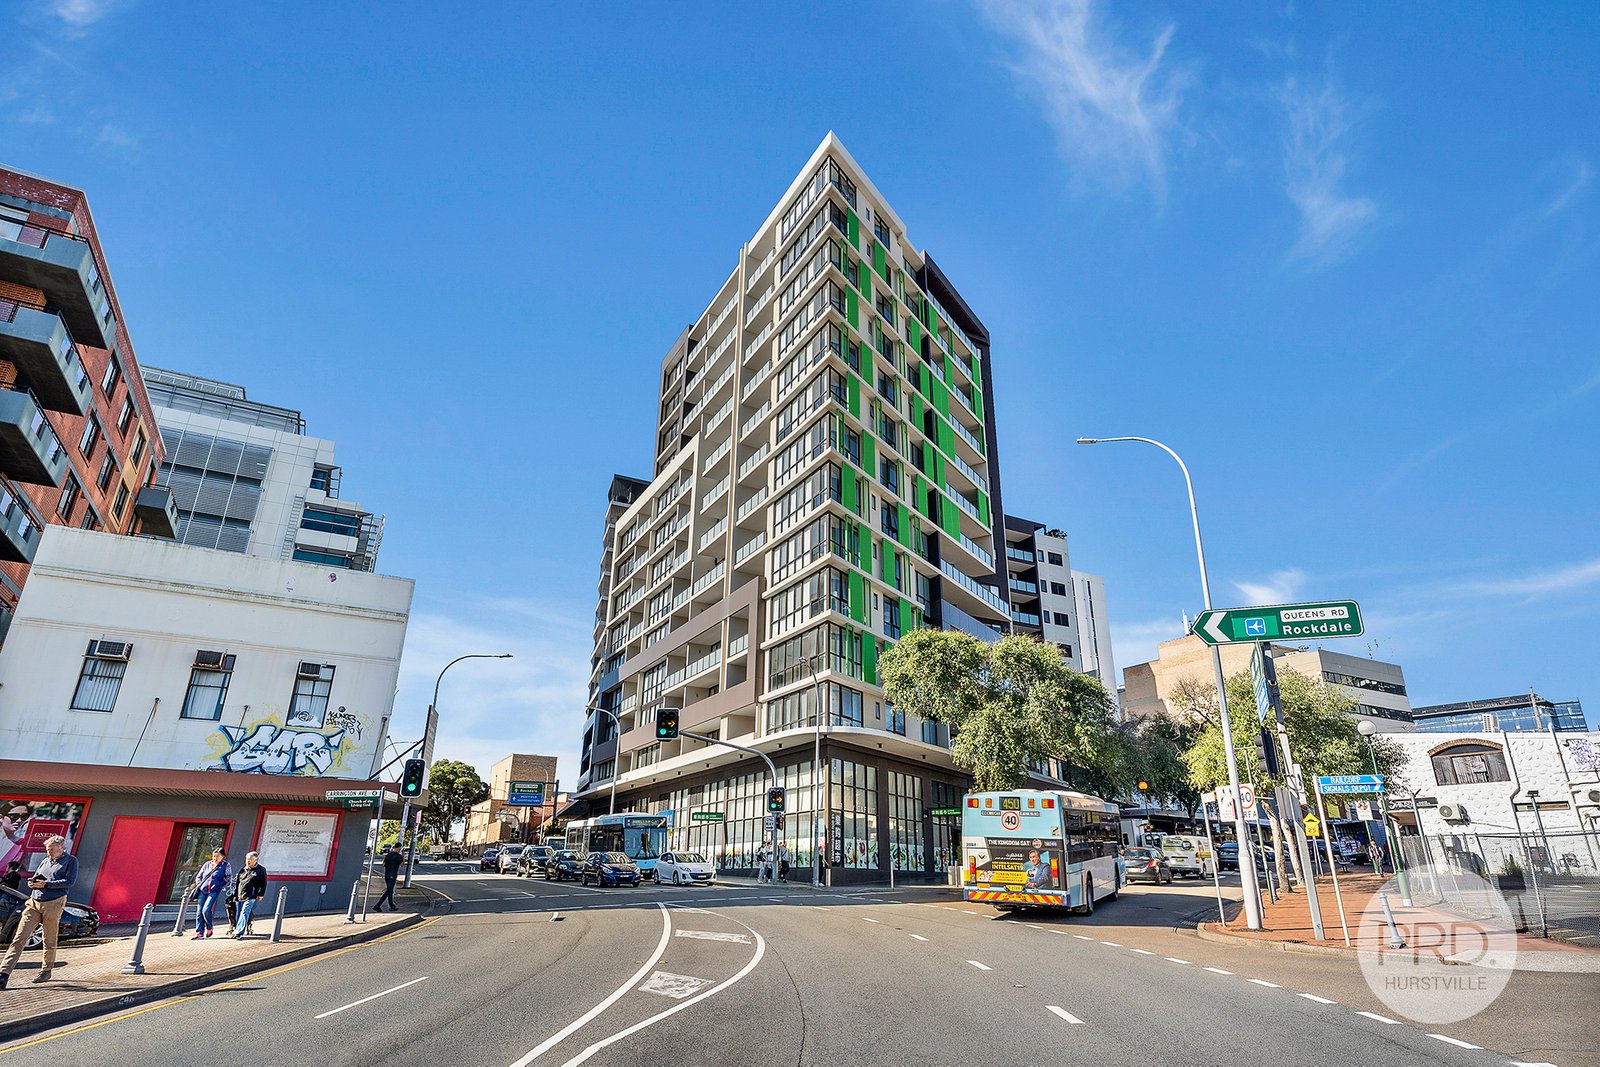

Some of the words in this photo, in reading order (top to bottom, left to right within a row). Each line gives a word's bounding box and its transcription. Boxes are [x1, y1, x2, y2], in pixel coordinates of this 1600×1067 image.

[1283, 609, 1326, 620] QUEENS
[1331, 608, 1345, 617] RD
[1282, 622, 1352, 635] Rockdale
[1330, 776, 1361, 784] RAILCORP
[1323, 785, 1350, 793] SIGNALS
[1351, 784, 1371, 792] DEPOT
[1240, 792, 1252, 803] 40
[1002, 799, 1020, 809] 450
[1004, 815, 1017, 825] 40
[1243, 811, 1257, 819] REA
